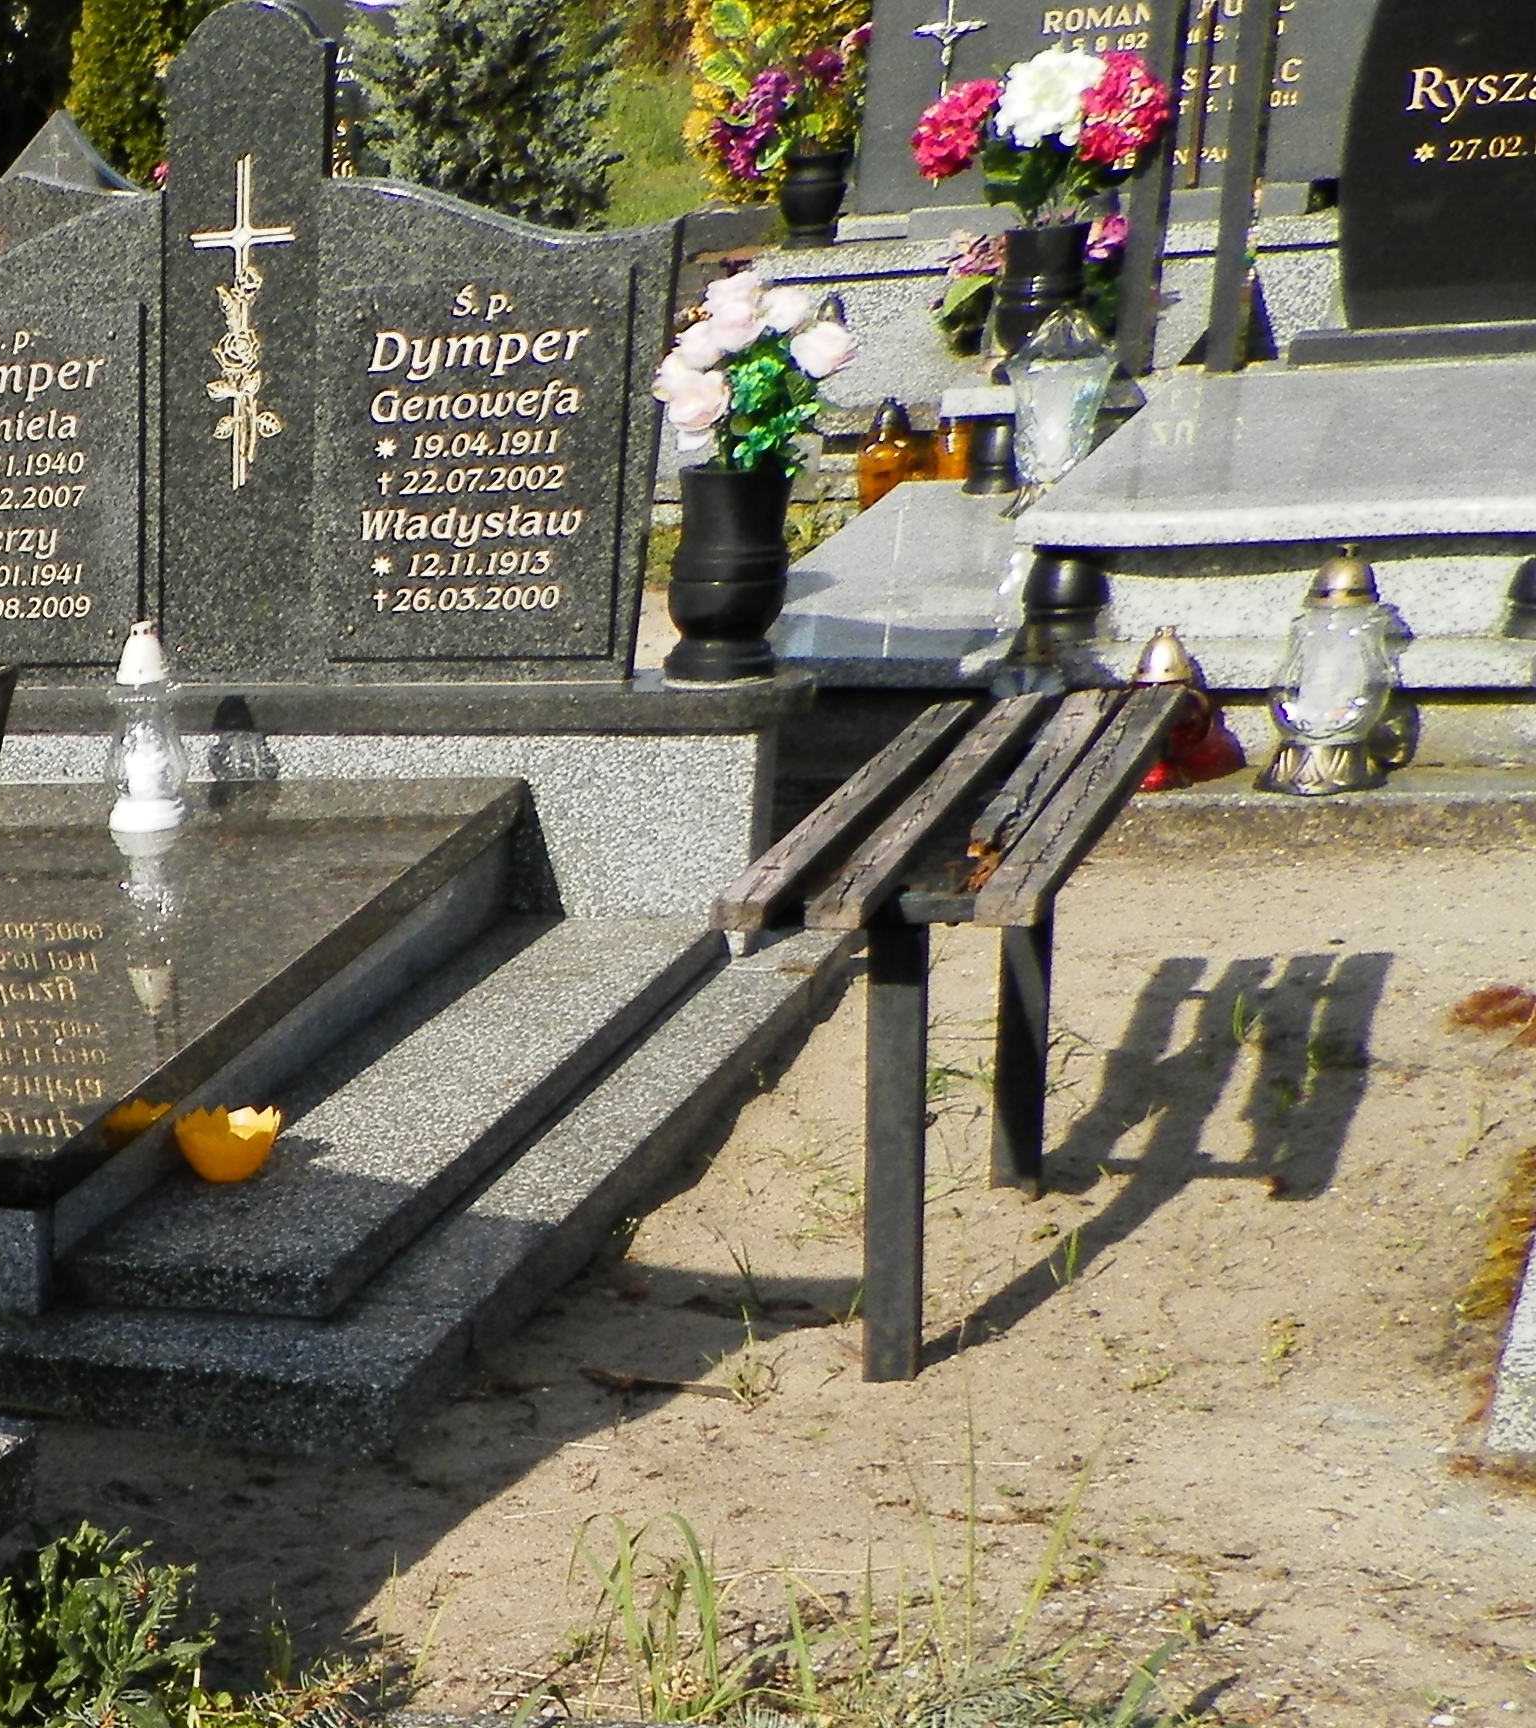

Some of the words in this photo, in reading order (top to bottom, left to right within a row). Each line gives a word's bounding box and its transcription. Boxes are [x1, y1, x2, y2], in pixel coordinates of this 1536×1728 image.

[1041, 2, 1151, 35] ROMAN
[1446, 135, 1536, 163] 27.02.
[452, 283, 478, 317] Ś.
[366, 326, 590, 382] Dymper
[369, 378, 582, 424] Genowefa
[410, 428, 561, 461] 19.04.1911
[398, 464, 565, 496] 22.07.2002
[359, 503, 585, 549] Władysław
[406, 550, 552, 578] 12.11.1913
[391, 584, 561, 614] 26.03.2000
